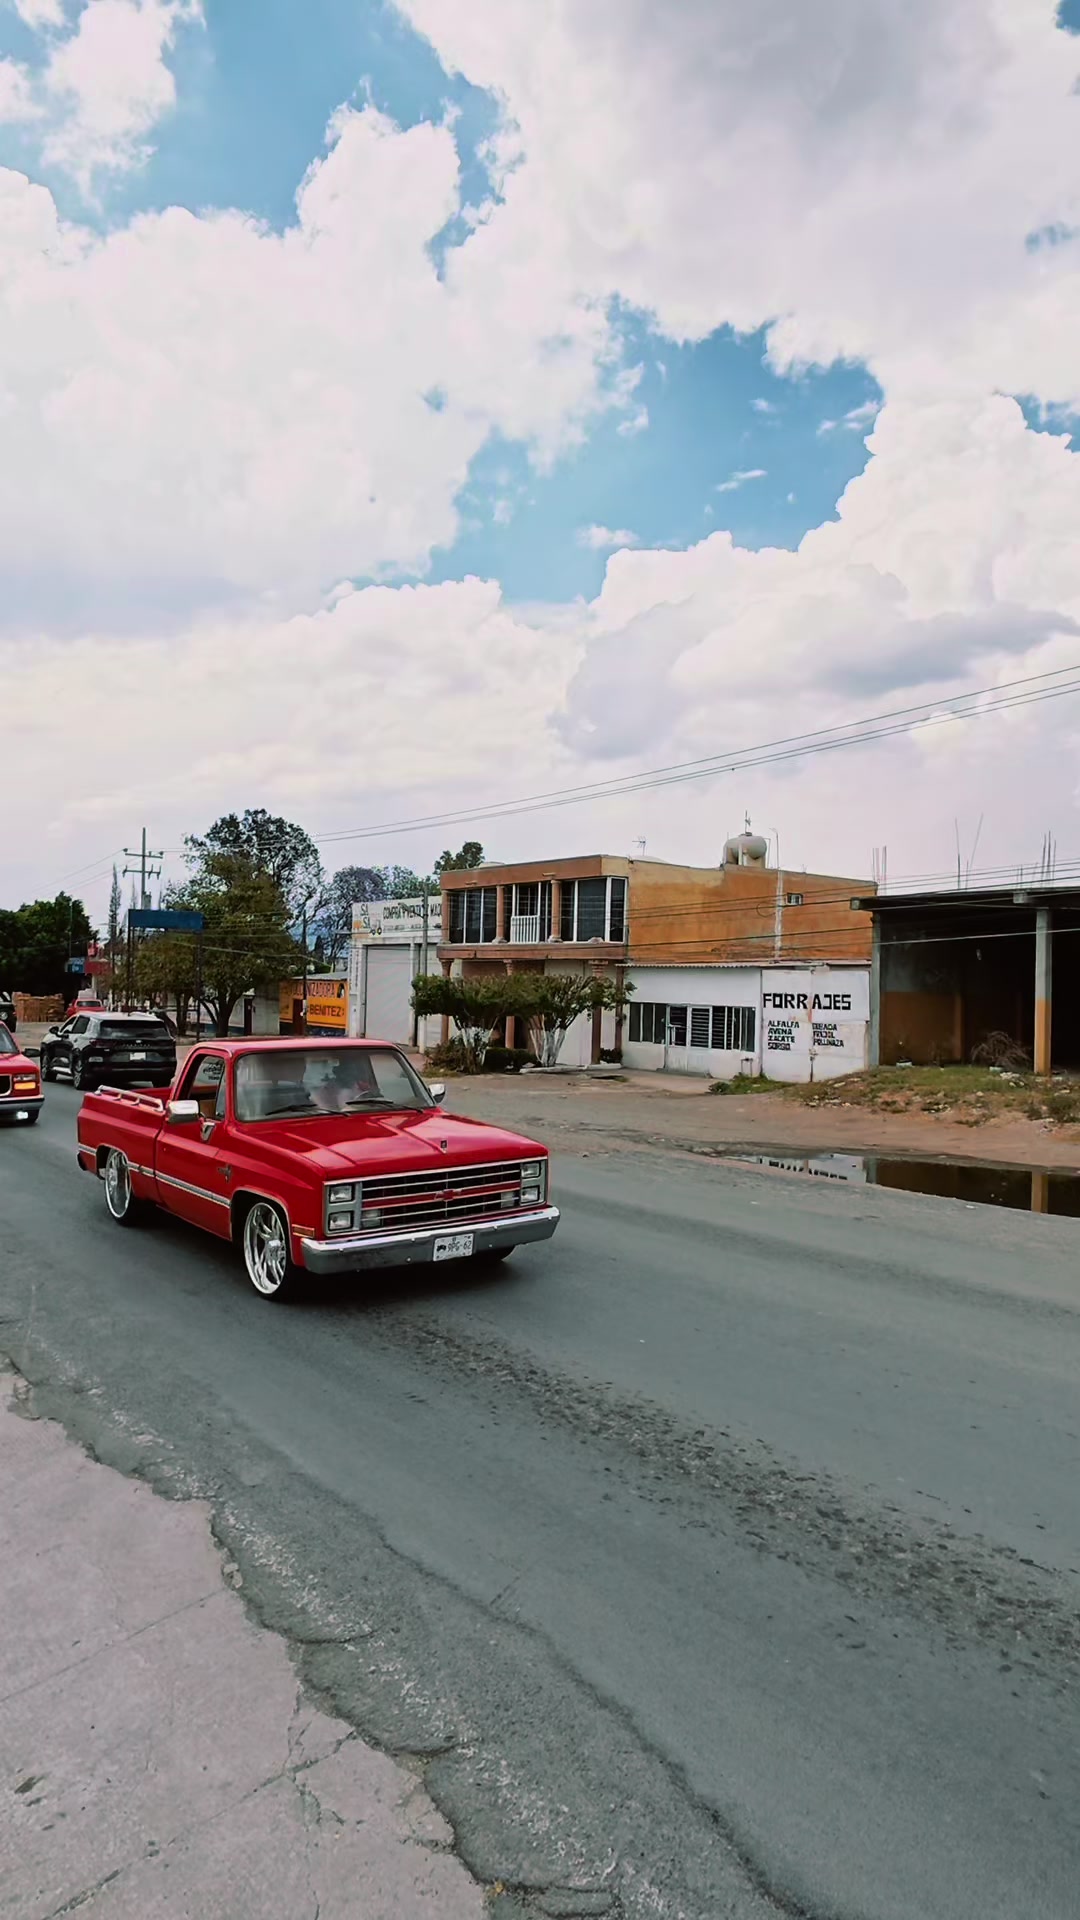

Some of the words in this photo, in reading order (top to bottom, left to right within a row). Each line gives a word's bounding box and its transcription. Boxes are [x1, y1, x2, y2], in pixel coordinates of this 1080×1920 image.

[763, 993, 851, 1010] FORRAJES
[309, 1004, 341, 1017] BENITEZ
[768, 1020, 800, 1028] ALFALFA
